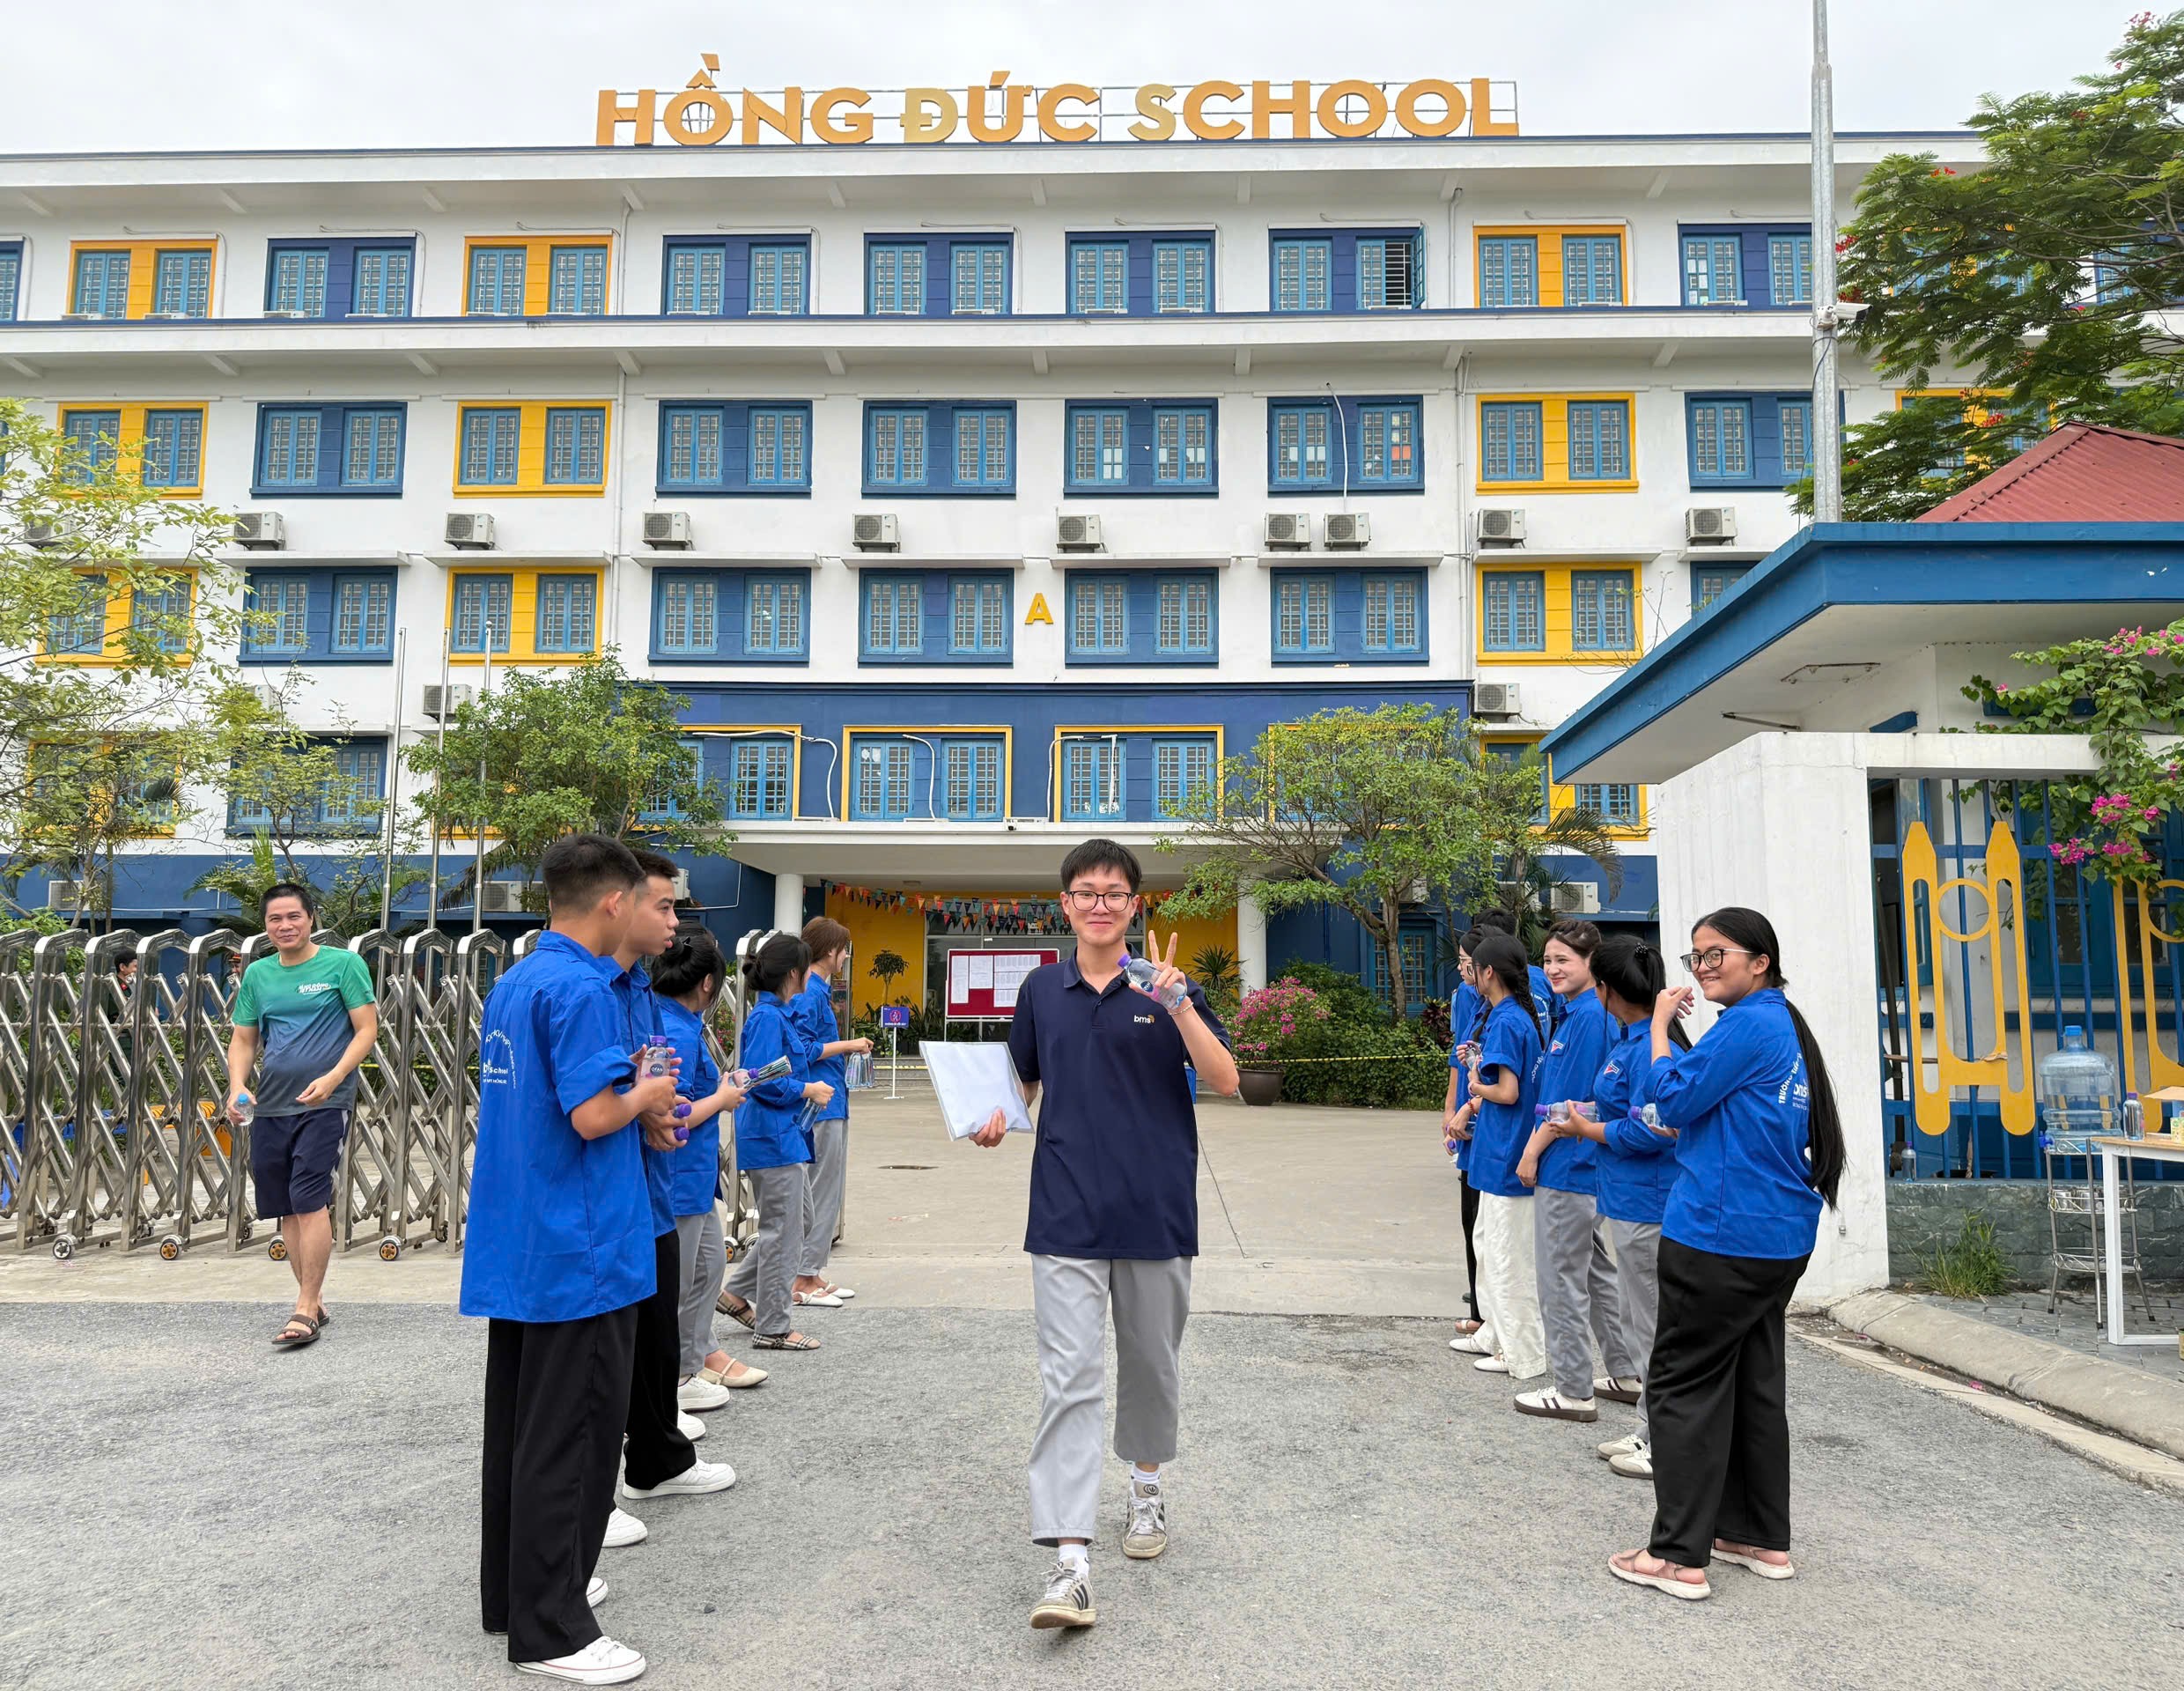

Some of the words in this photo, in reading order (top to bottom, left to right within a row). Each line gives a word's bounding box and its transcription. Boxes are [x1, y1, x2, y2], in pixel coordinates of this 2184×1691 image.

[596, 53, 874, 145] HỒNG
[900, 70, 1100, 144] ĐỨC
[1127, 78, 1519, 141] SCHOOL
[1024, 593, 1054, 624] A
[1133, 1015, 1151, 1023] bms
